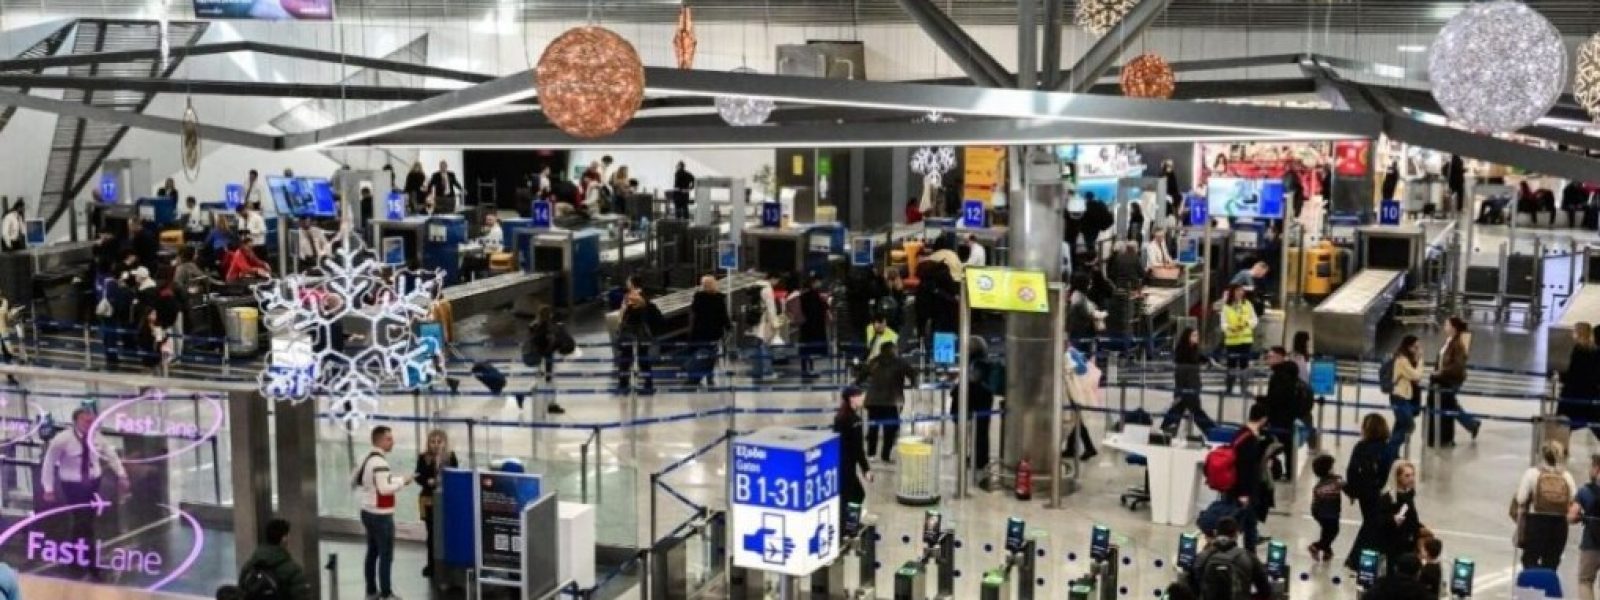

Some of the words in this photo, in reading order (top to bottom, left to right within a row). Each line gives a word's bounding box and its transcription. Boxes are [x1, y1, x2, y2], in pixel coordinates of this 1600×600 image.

[535, 207, 548, 221] 14
[967, 206, 981, 220] 12
[1383, 205, 1398, 220] 10
[115, 413, 153, 434] Fast
[736, 473, 751, 501] B
[757, 476, 799, 508] 1-31
[804, 478, 814, 508] B
[815, 467, 838, 501] 1-31
[27, 531, 90, 567] Fast
[95, 538, 162, 575] Lane
